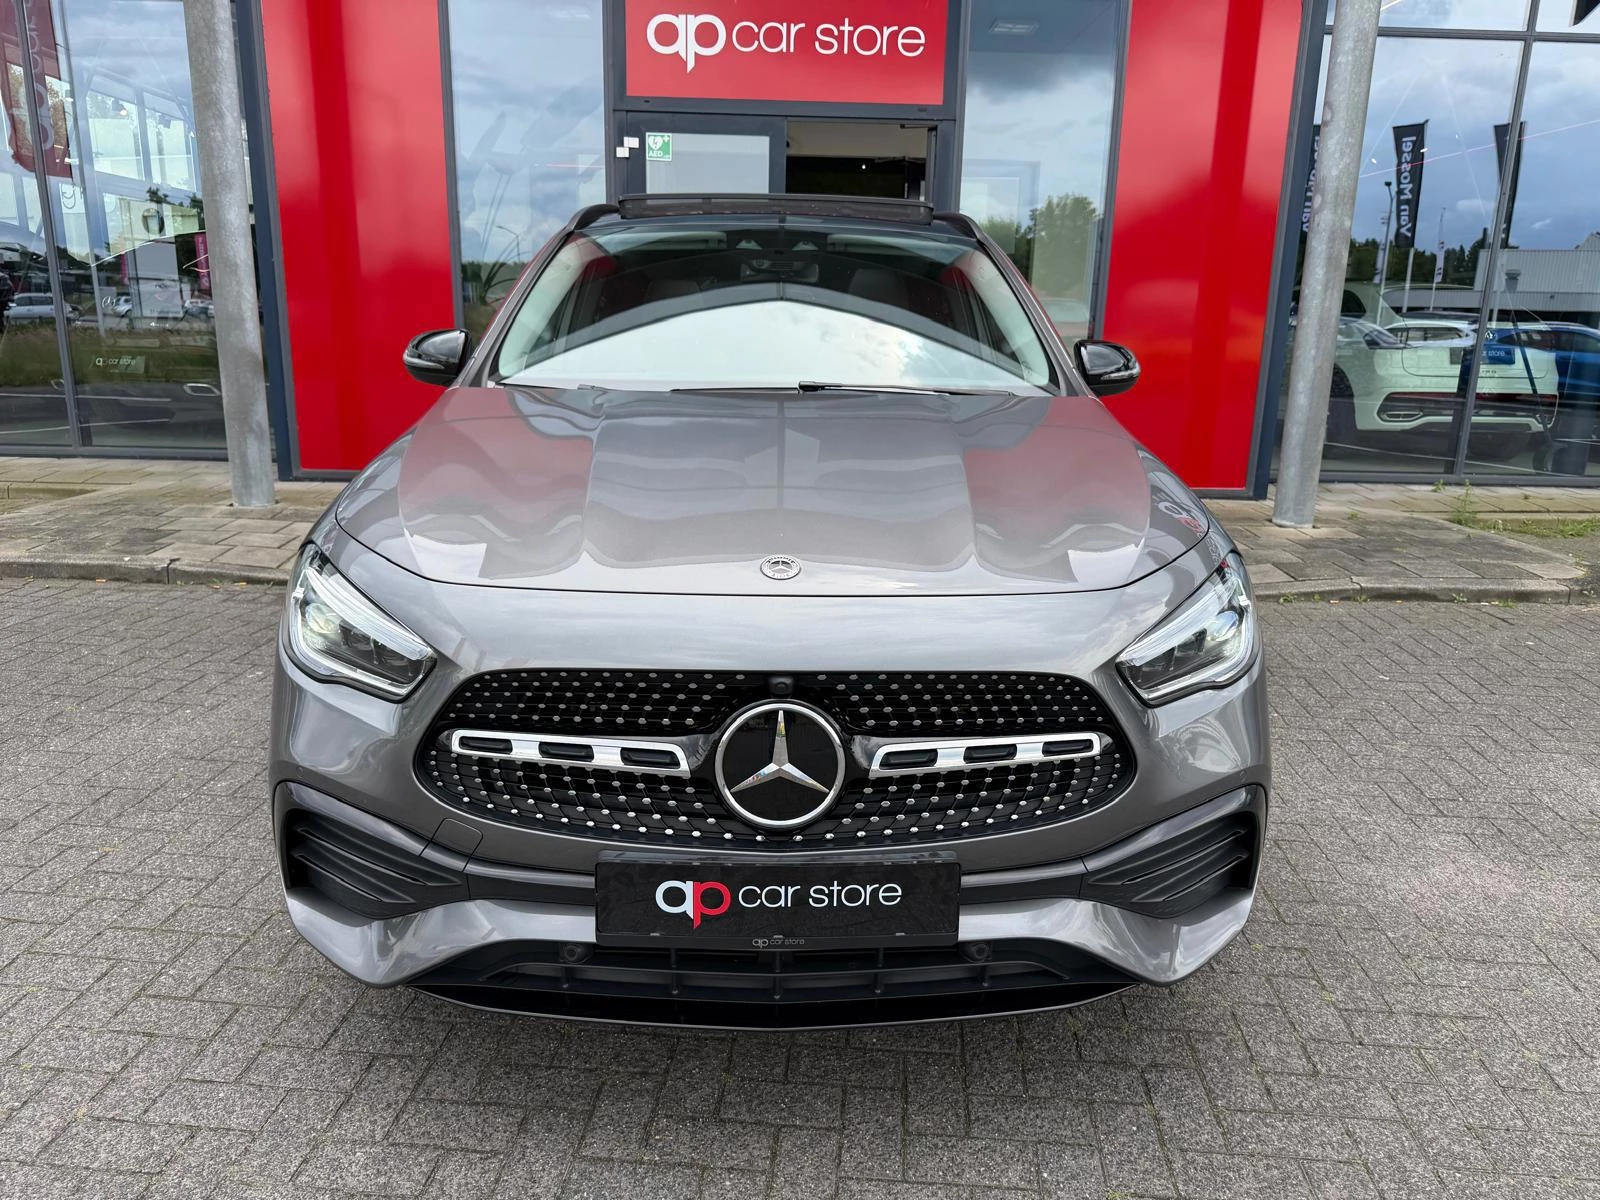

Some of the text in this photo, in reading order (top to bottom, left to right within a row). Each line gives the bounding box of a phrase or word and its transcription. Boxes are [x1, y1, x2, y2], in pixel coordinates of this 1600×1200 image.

[732, 20, 805, 53] car
[814, 18, 926, 57] store
[738, 883, 801, 908] car
[808, 881, 902, 908] store
[784, 937, 805, 945] store
